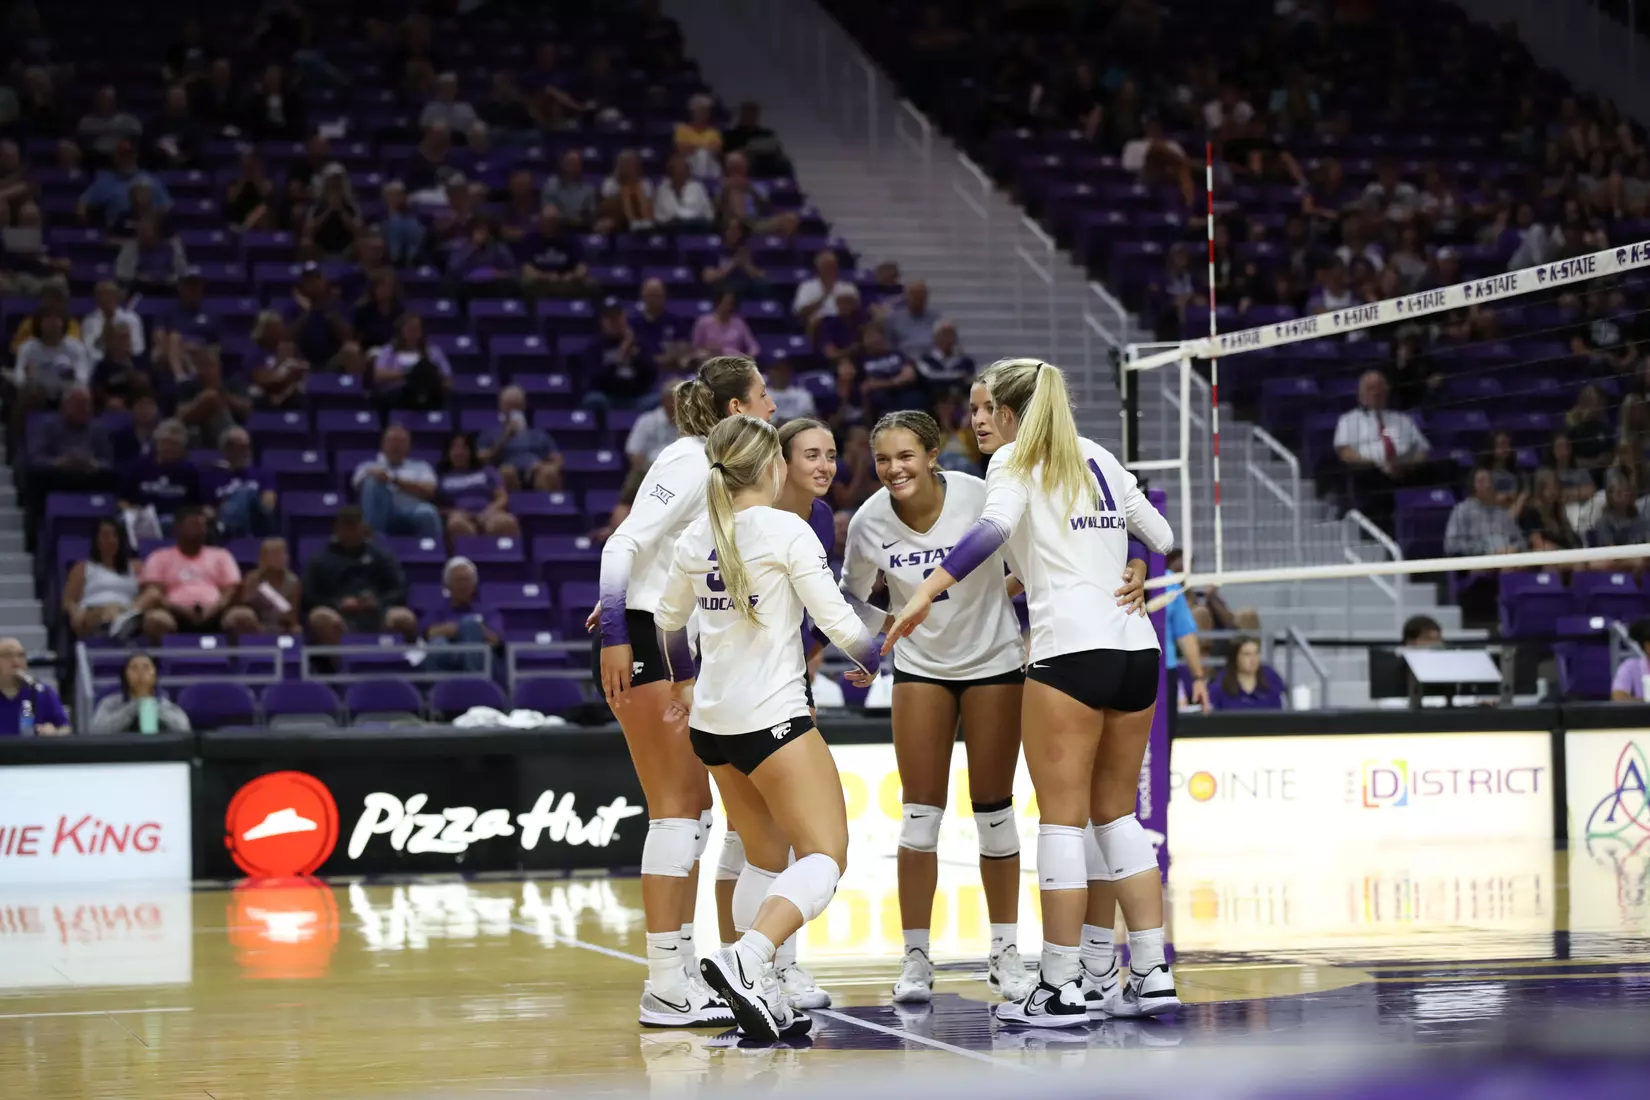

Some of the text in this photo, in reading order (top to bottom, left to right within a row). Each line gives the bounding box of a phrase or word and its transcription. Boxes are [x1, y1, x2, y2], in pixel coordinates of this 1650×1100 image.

[1407, 290, 1446, 312] K-STATE
[1475, 274, 1517, 298] K-STATE
[1549, 255, 1596, 282] K-STATE
[1630, 243, 1650, 264] K-S
[1070, 515, 1126, 531] WILDCA
[1371, 766, 1545, 800] DISTRICT
[0, 826, 45, 857] IE
[348, 789, 644, 860] Pizza Hut
